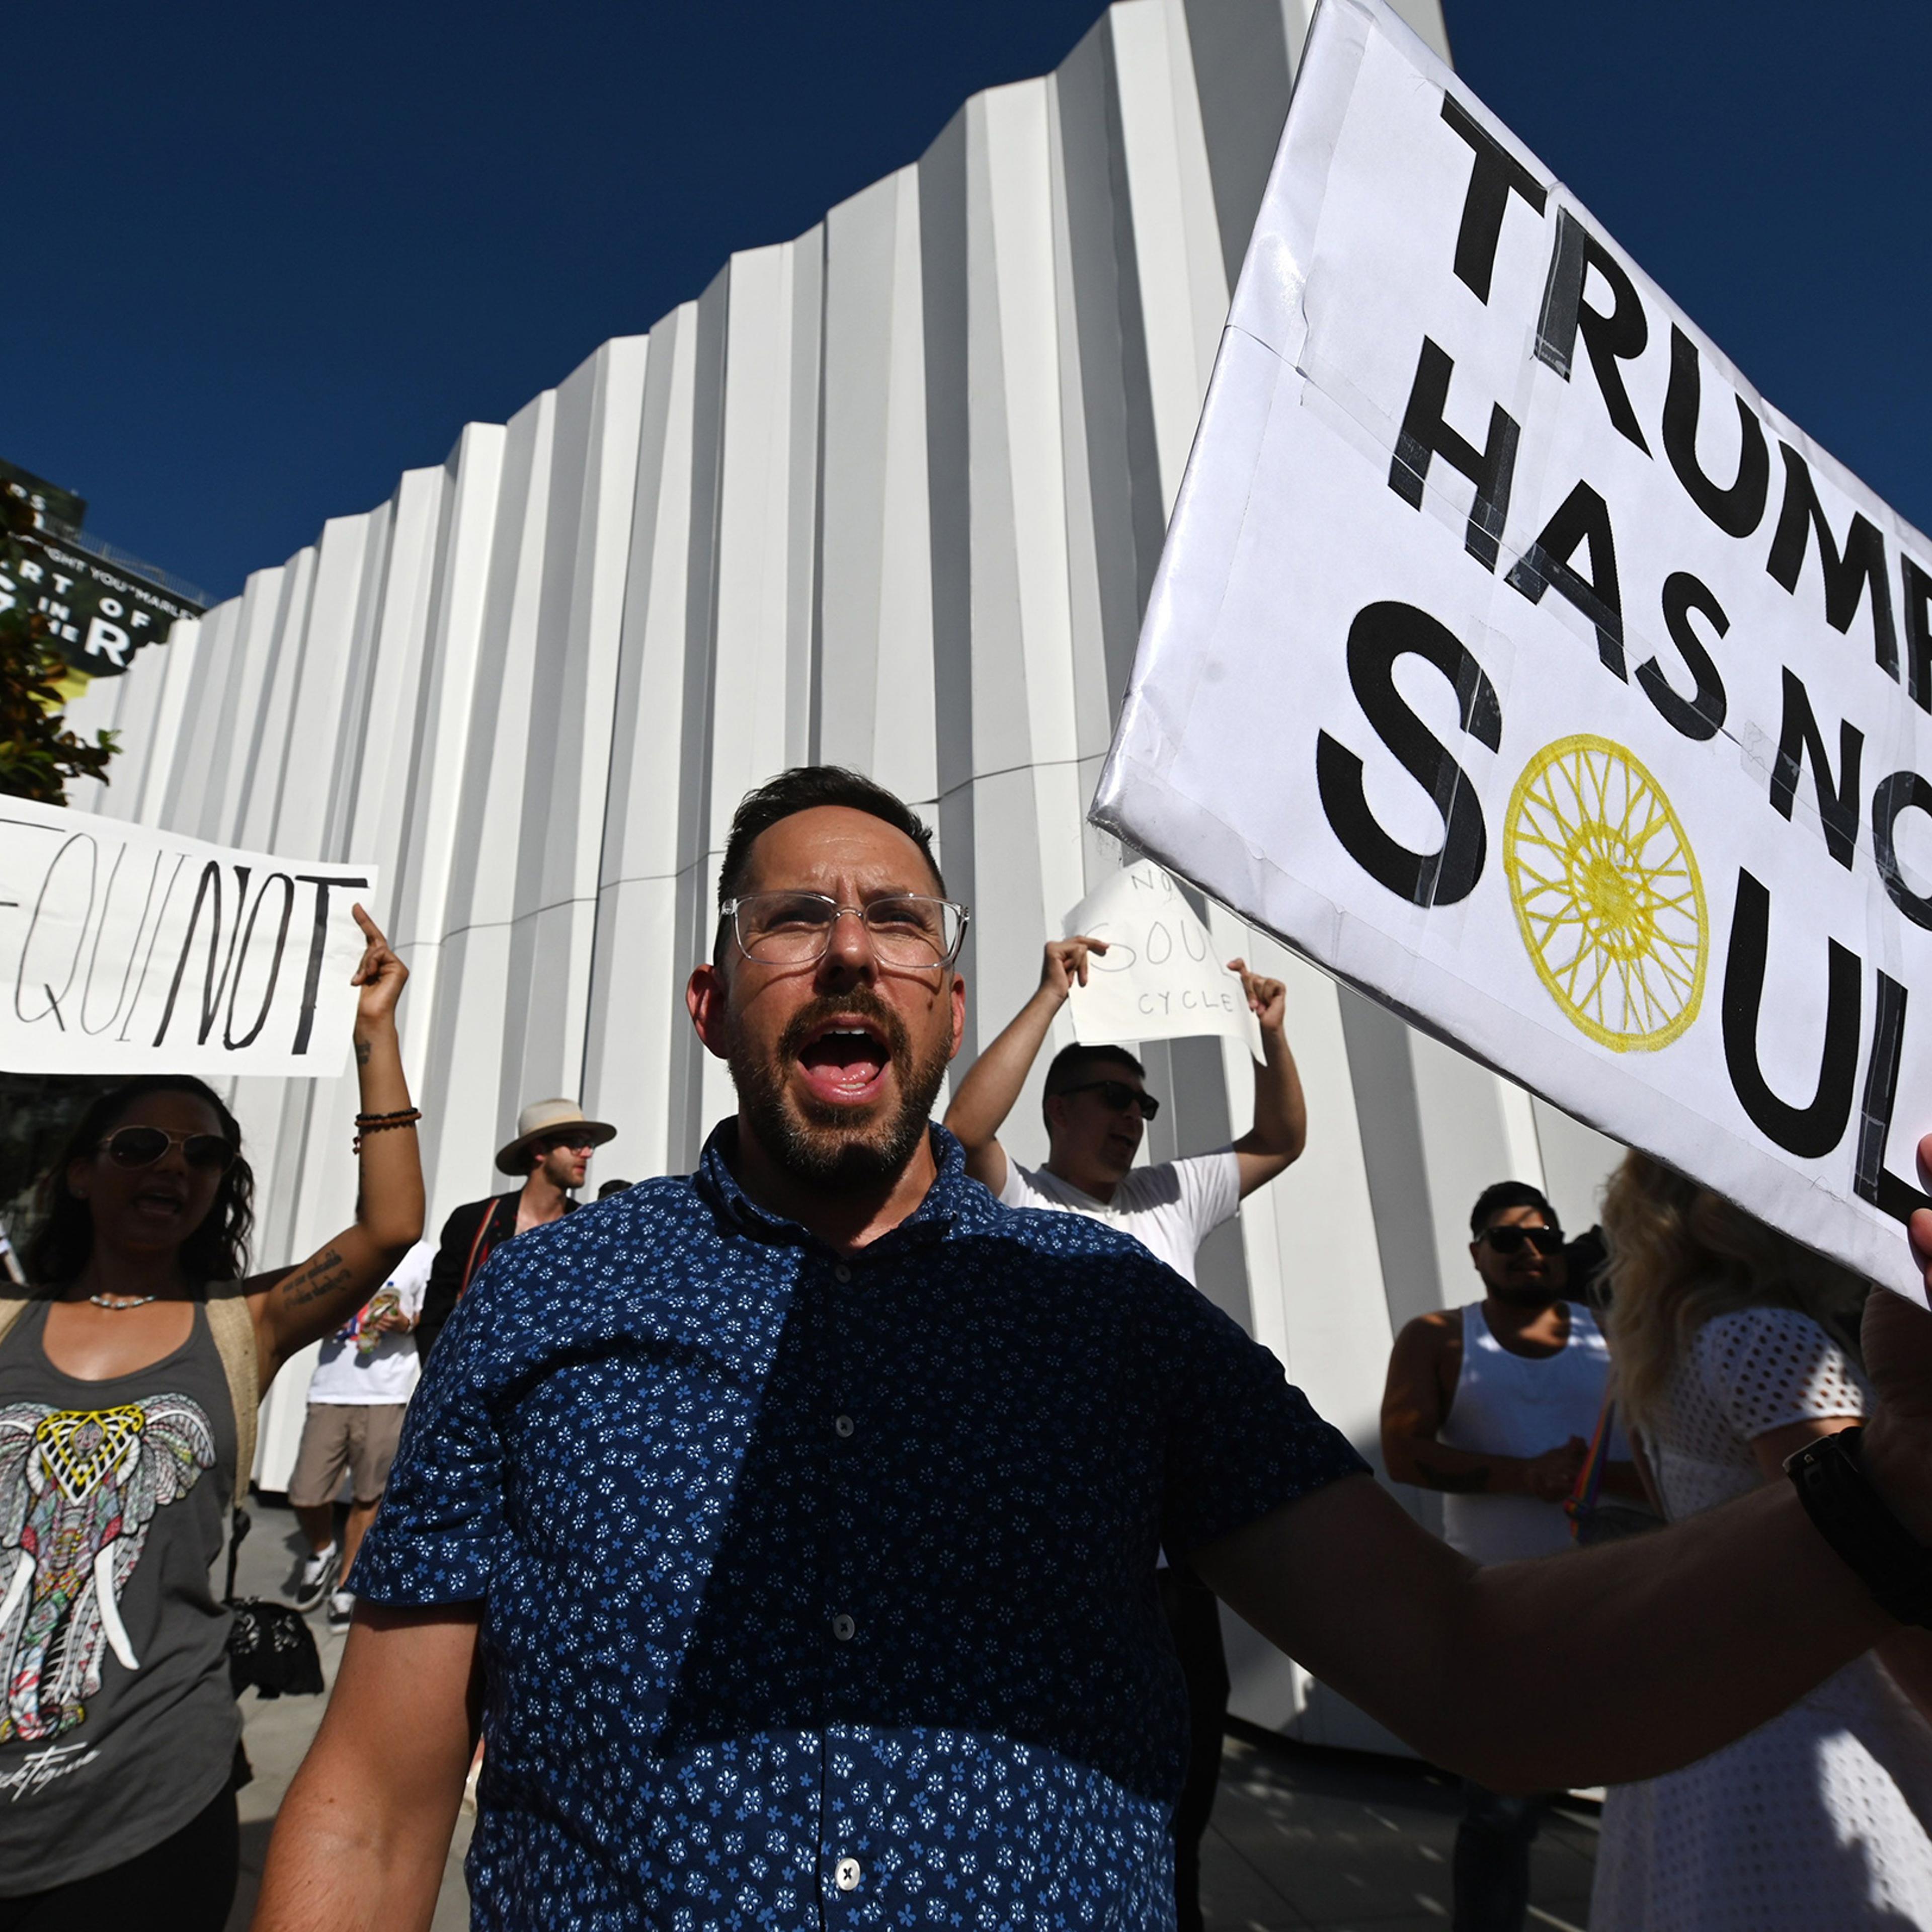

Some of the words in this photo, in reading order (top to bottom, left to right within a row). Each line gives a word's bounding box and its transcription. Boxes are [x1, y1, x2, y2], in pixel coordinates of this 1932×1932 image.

[0, 559, 73, 594] RT
[98, 597, 150, 627] OF
[90, 566, 128, 592] YOU
[1388, 334, 1730, 741] HAS
[1769, 665, 1932, 932] NO
[1131, 868, 1172, 892] NO
[0, 819, 370, 1056] QUINOT
[1138, 991, 1233, 1014] CYCLE
